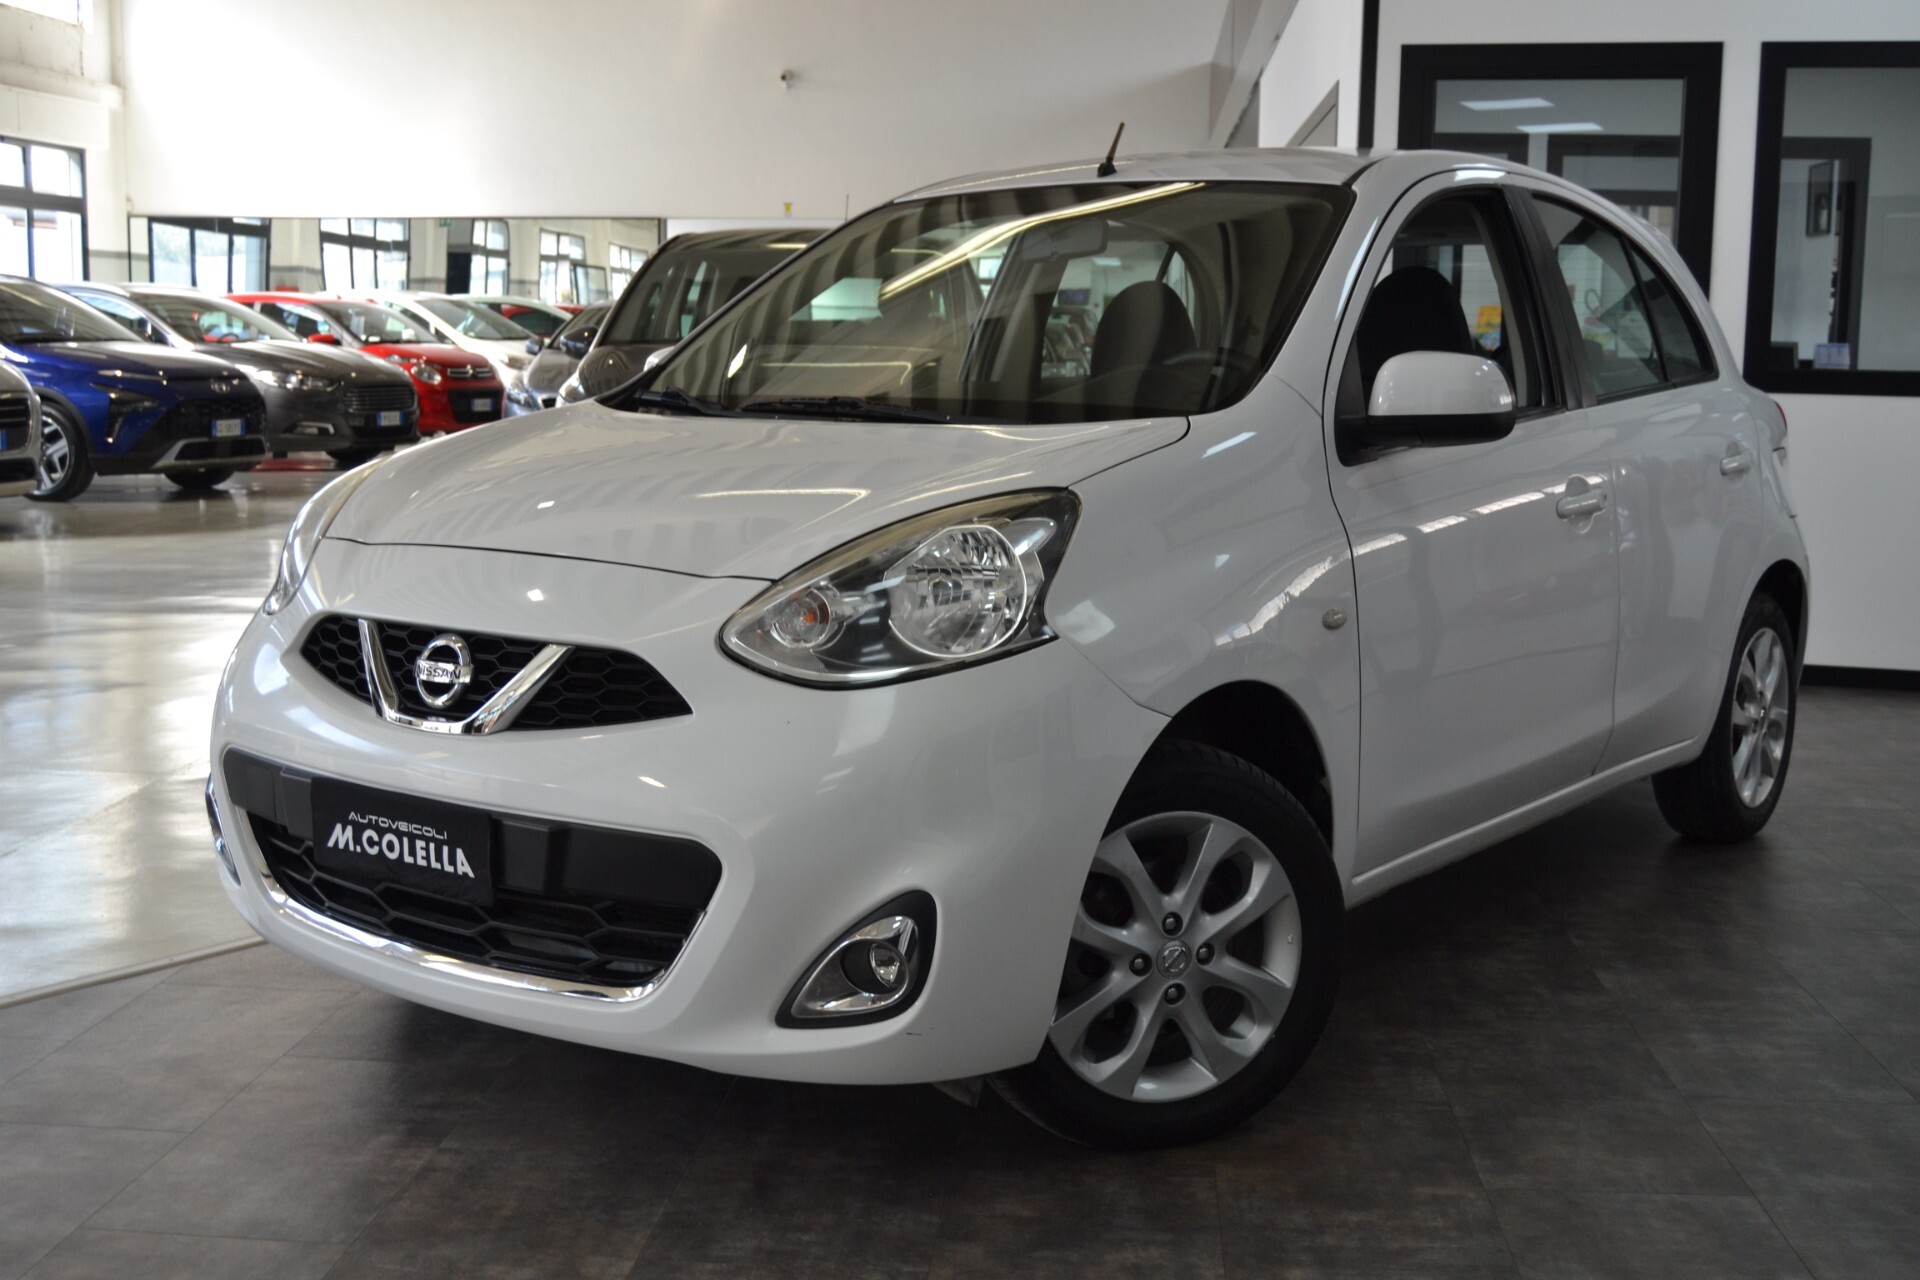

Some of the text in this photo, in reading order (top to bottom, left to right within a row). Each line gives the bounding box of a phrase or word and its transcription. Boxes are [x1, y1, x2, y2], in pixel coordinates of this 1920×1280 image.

[416, 664, 461, 680] NISSAN
[348, 811, 448, 840] AUTOVEICOLI
[326, 822, 476, 878] M.COLELLA
